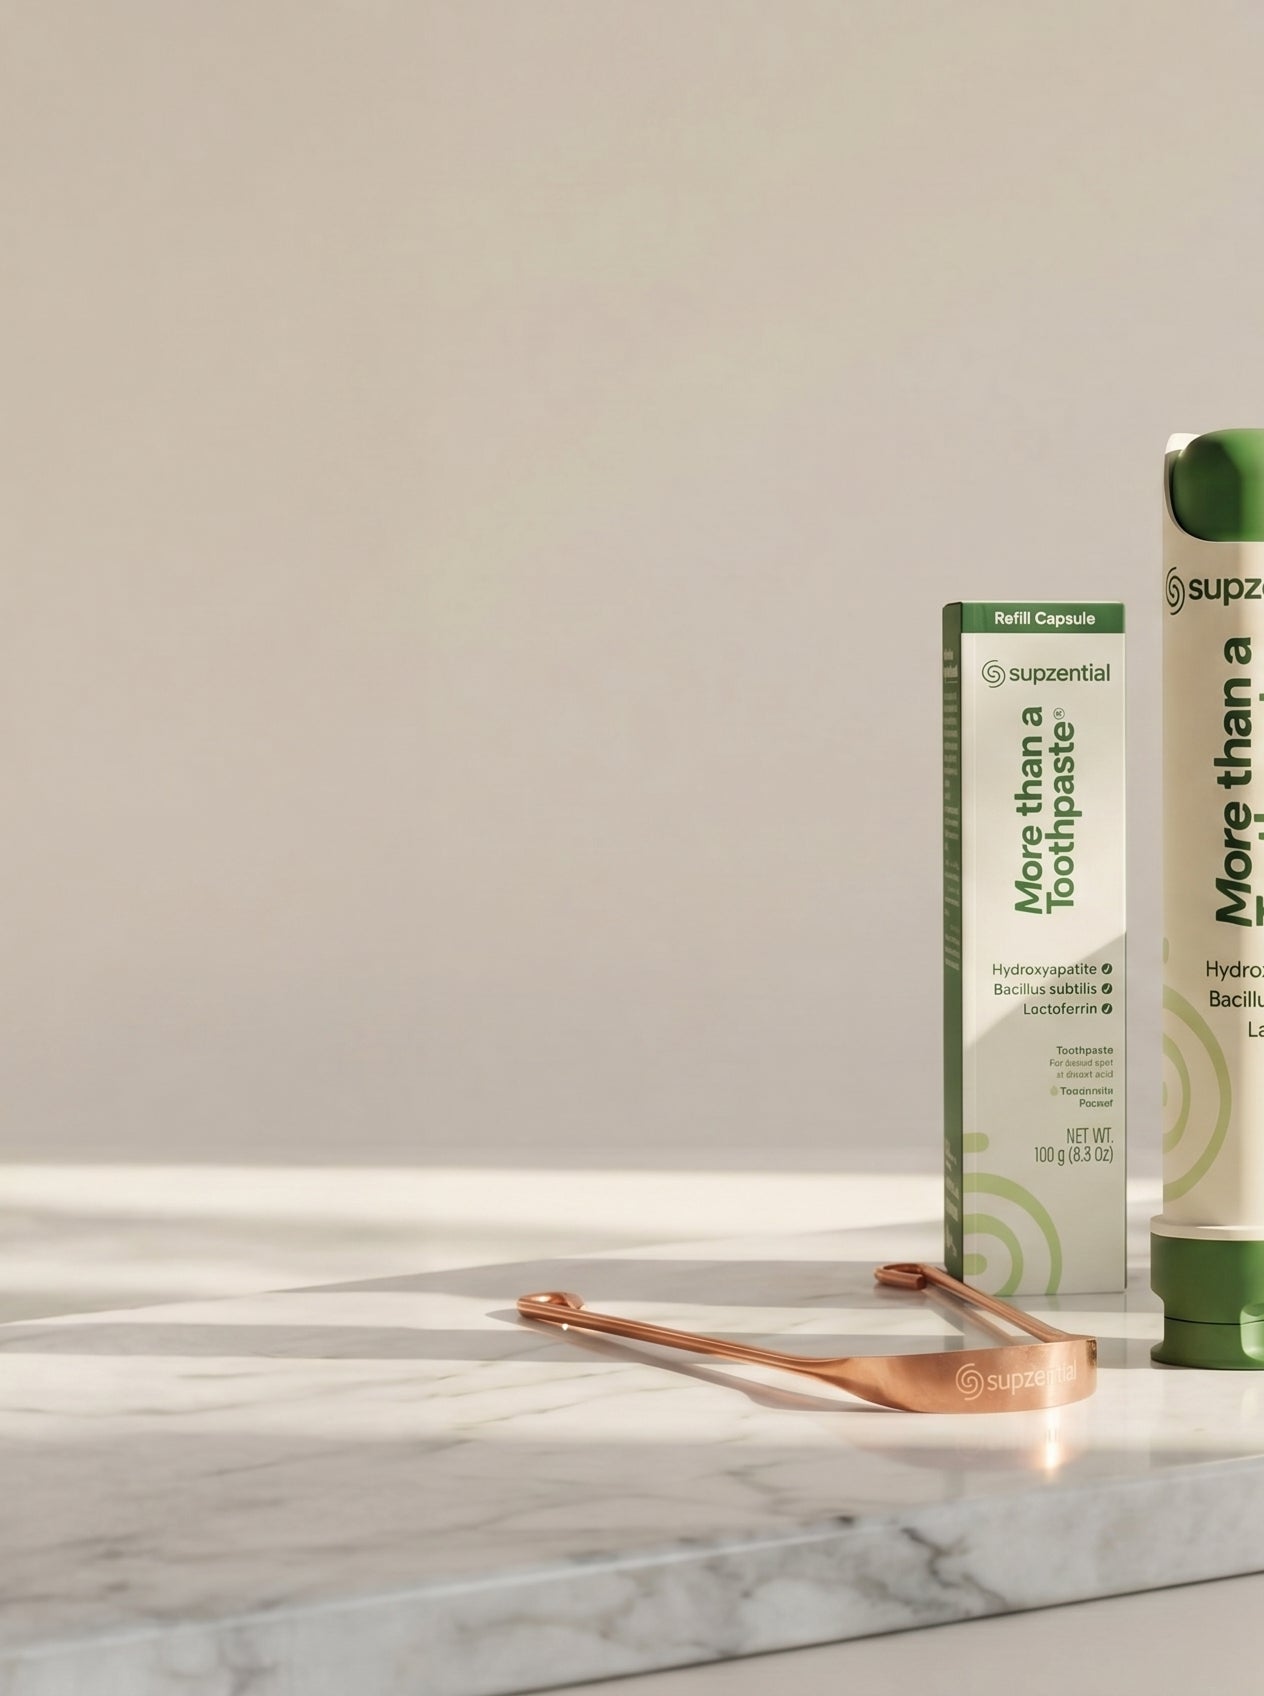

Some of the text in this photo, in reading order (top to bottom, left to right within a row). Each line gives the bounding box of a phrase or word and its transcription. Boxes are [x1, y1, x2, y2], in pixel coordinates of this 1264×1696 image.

[994, 611, 1096, 628] Refill Capsule
[1009, 663, 1111, 686] supzential
[1213, 636, 1253, 928] More than a
[1014, 706, 1043, 915] More than a
[992, 963, 1098, 978] Hydroxyapatite
[993, 982, 1097, 996] Bacillus subtilis
[1023, 1002, 1098, 1015] Lactoferrin
[1067, 1127, 1114, 1144] NET WT.
[1034, 1146, 1054, 1162] 100
[1057, 1149, 1065, 1167] g
[1068, 1145, 1091, 1165] (8.3
[987, 1359, 1077, 1396] supzential
